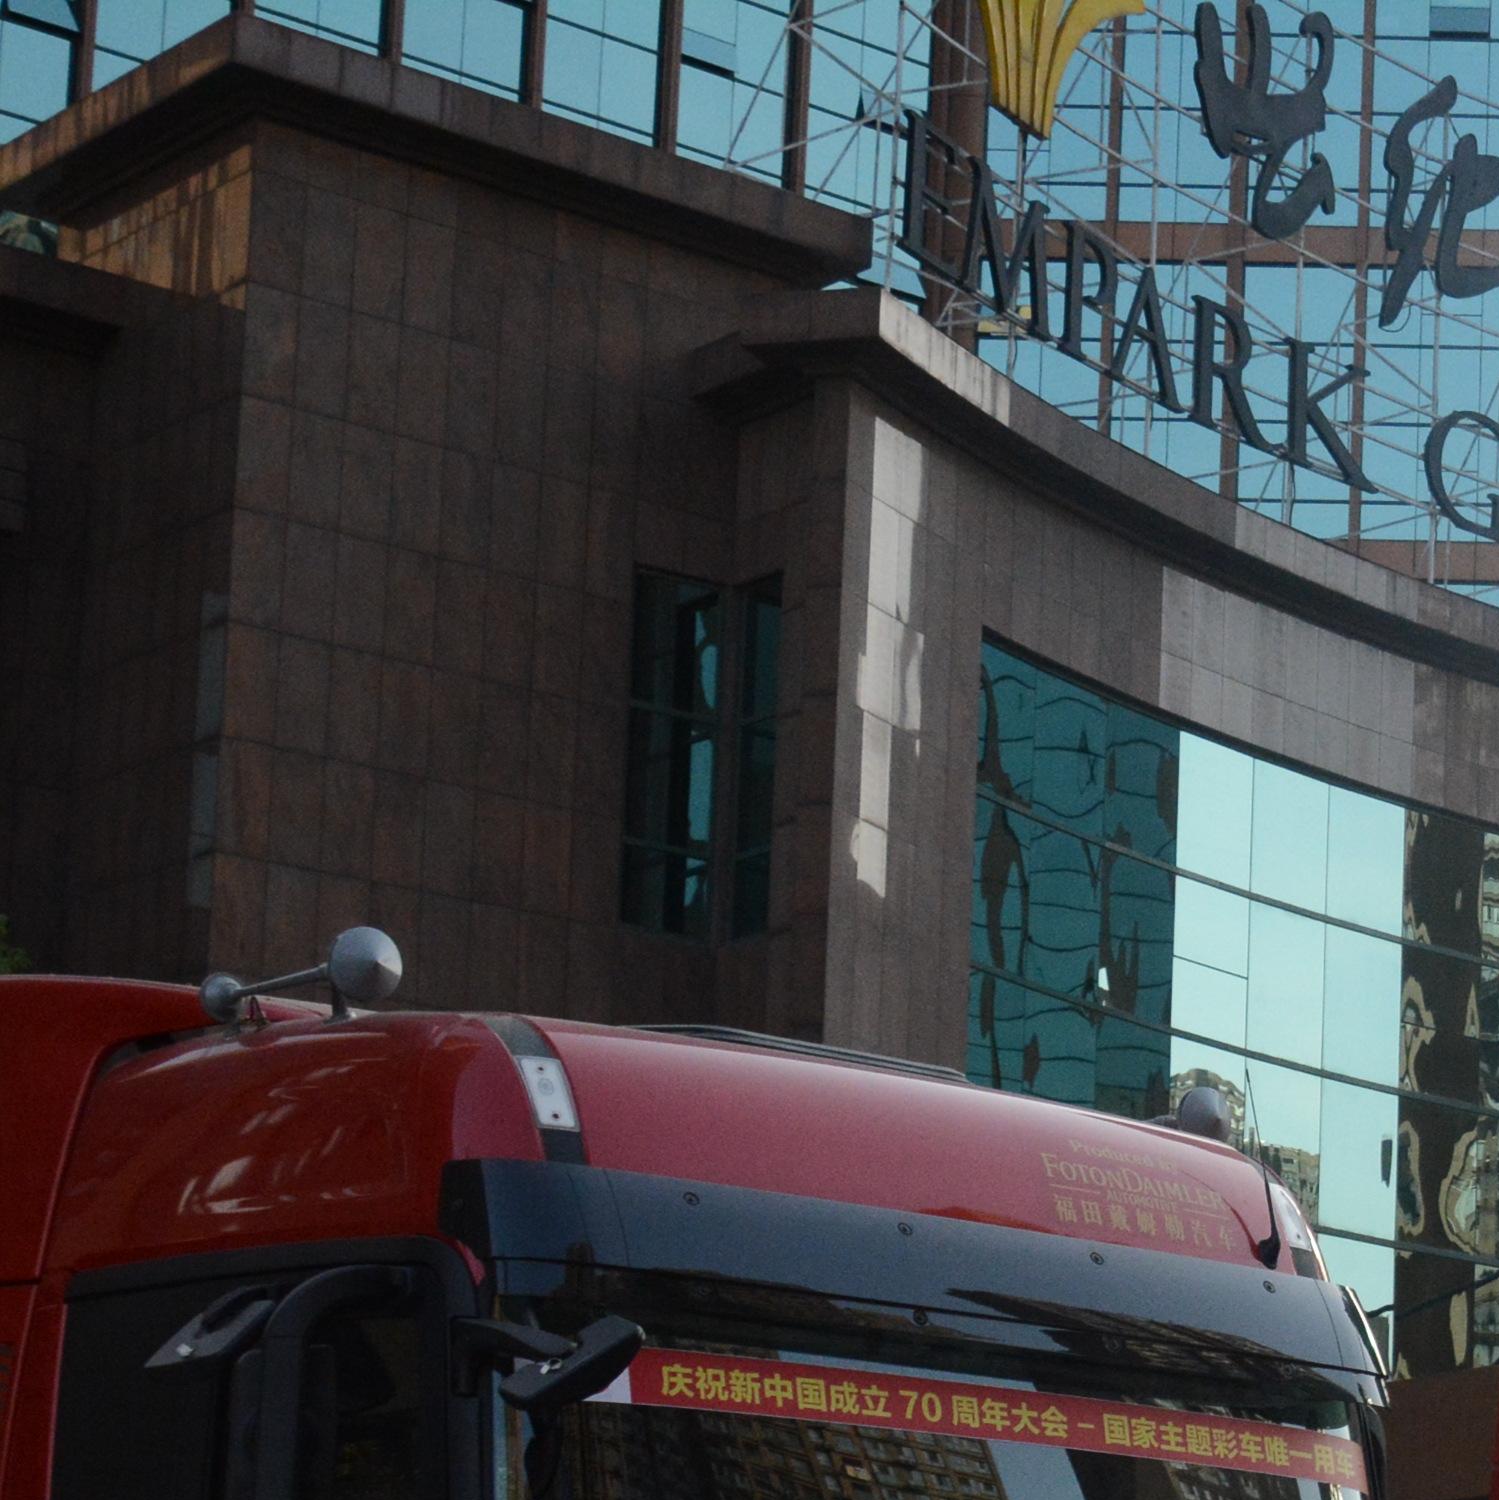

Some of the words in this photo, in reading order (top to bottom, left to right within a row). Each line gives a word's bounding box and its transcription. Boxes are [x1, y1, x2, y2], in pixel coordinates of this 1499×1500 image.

[900, 109, 1378, 495] EMPARK
[661, 1363, 892, 1418] 庆祝新中国成立
[898, 1389, 943, 1423] 70
[951, 1394, 1069, 1439] 周年大会
